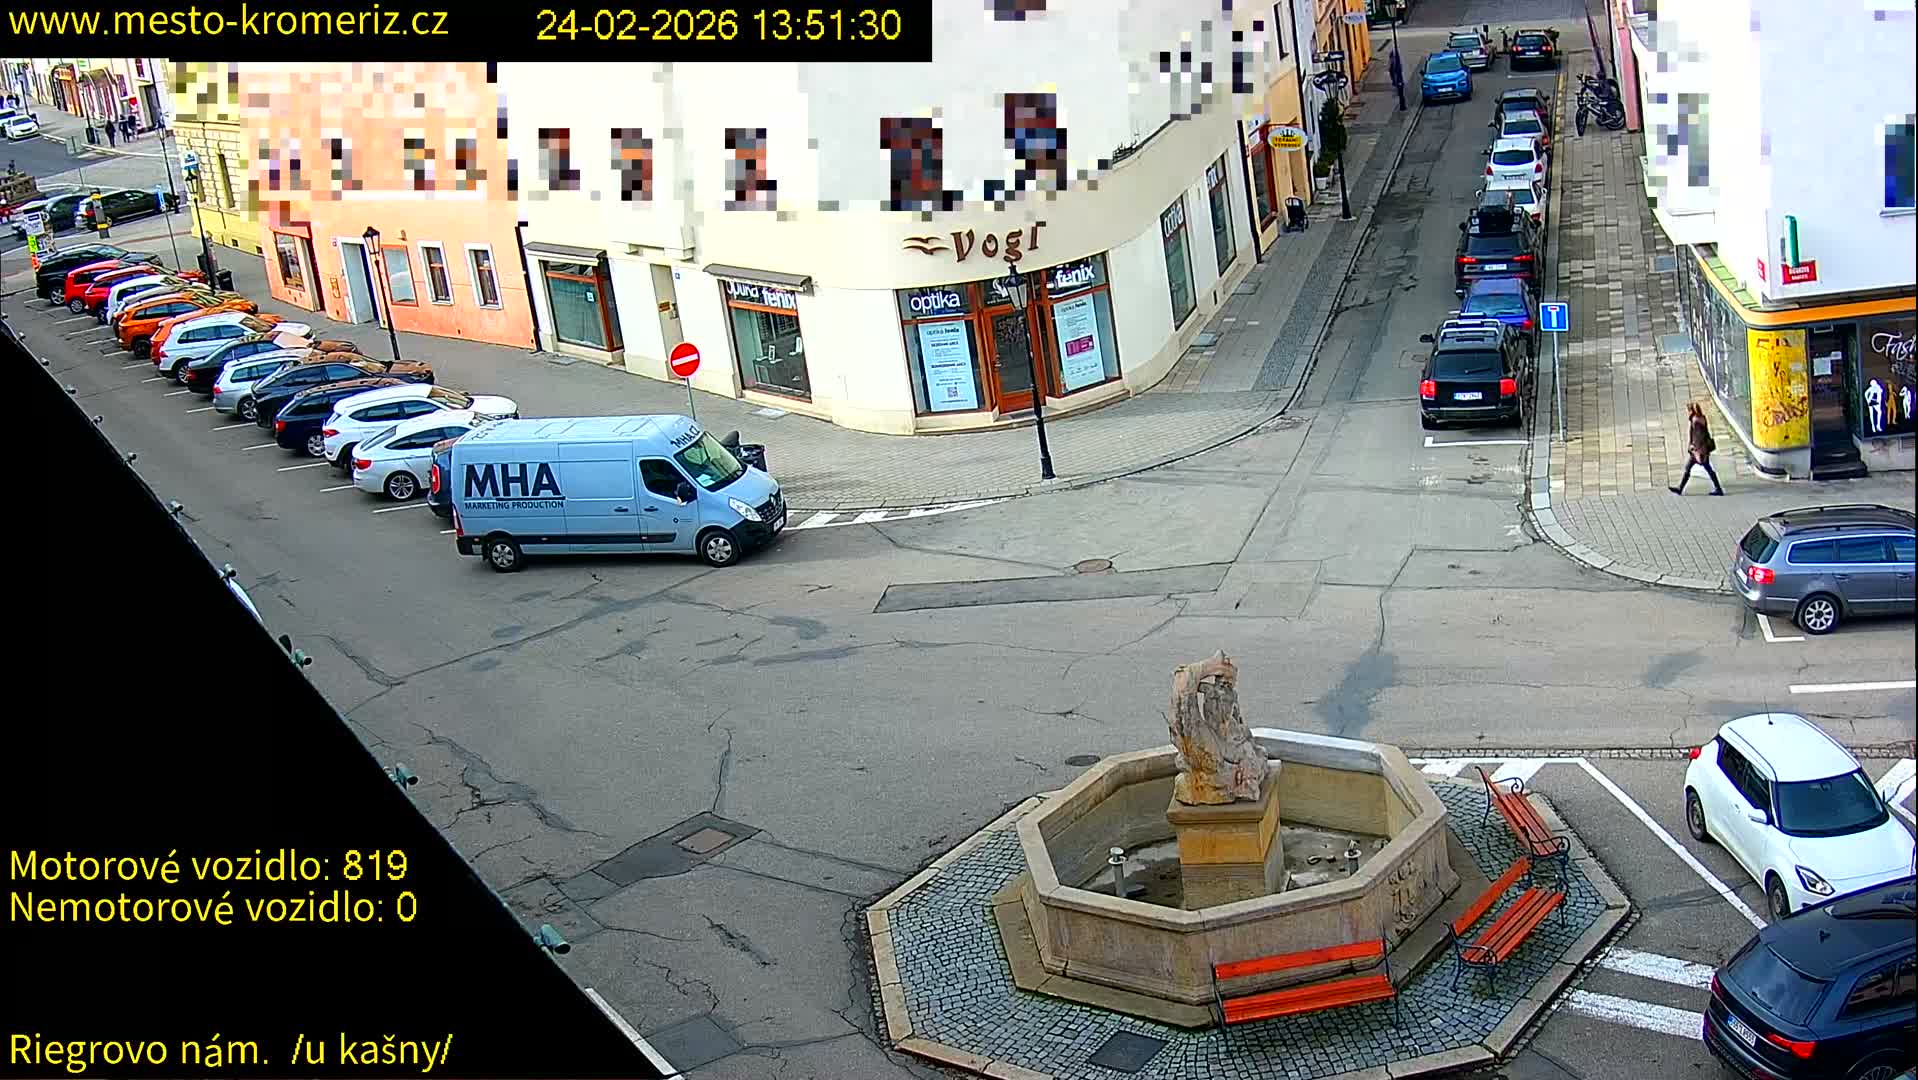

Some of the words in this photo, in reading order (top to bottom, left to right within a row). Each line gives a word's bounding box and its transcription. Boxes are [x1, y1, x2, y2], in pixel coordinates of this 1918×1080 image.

[910, 290, 961, 314] optika
[464, 463, 562, 497] MHA
[464, 501, 510, 510] MARKETING
[512, 500, 564, 510] PRODUCTION
